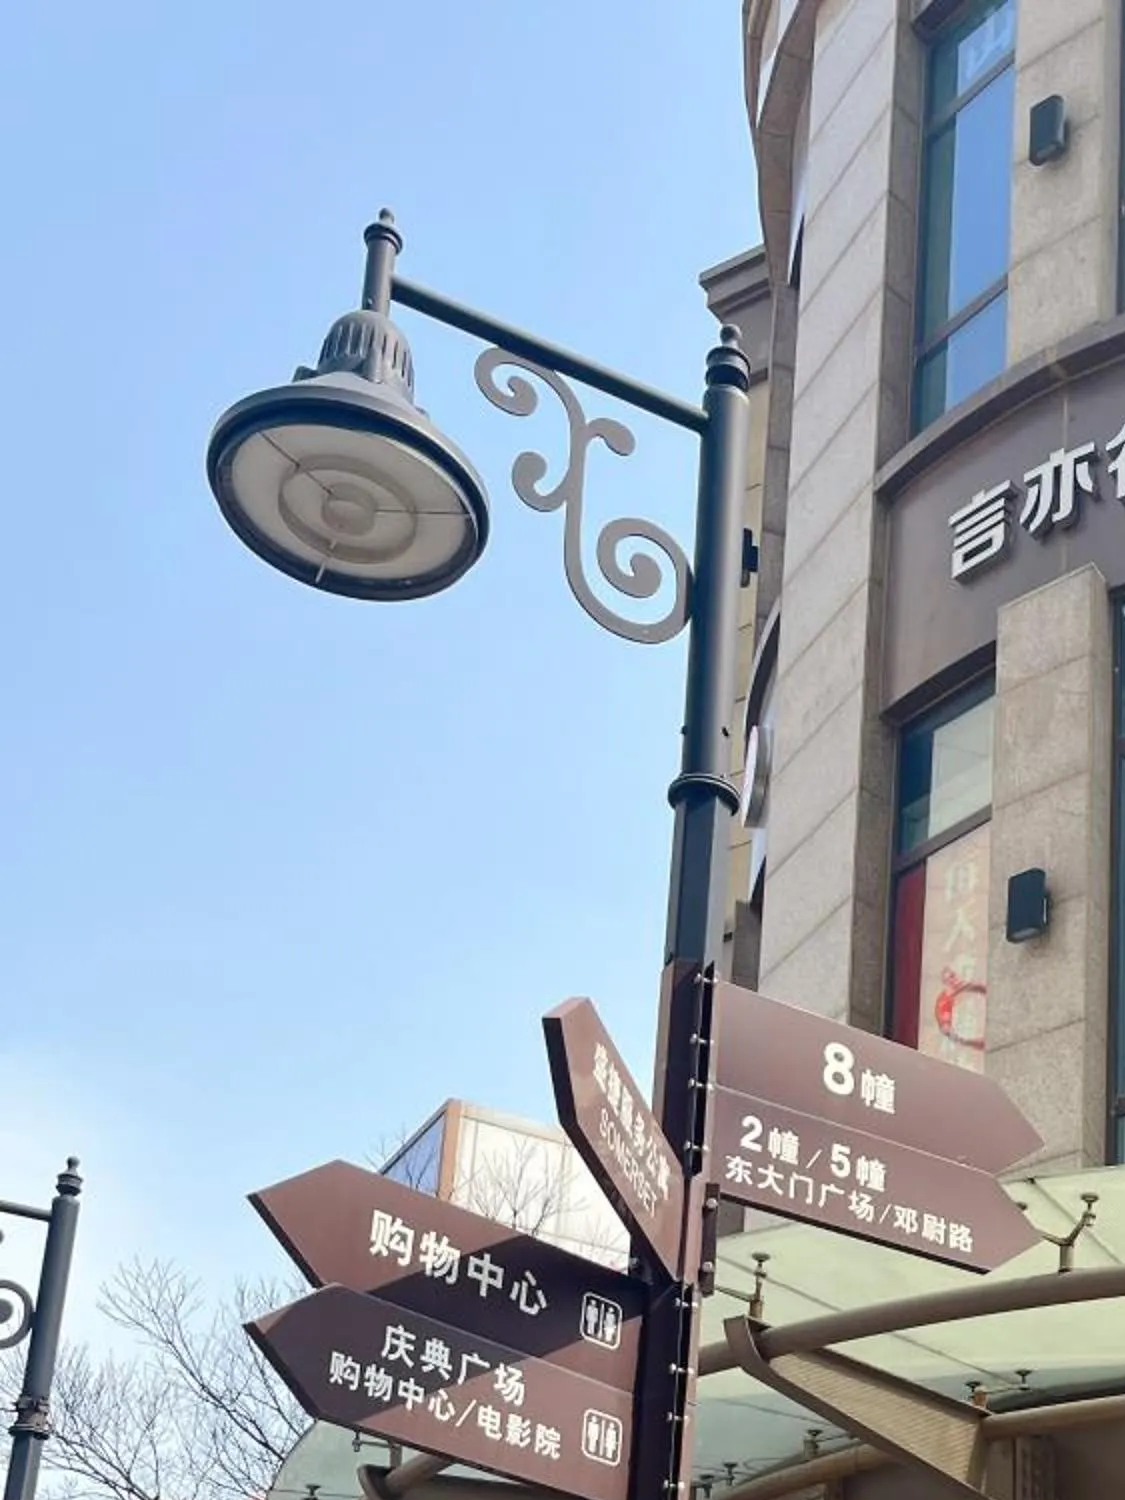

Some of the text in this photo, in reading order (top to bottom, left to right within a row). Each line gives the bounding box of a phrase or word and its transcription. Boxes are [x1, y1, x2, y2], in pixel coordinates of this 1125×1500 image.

[823, 1042, 895, 1114] 8幢
[600, 1108, 657, 1217] SOMERSET
[725, 1155, 973, 1252] 东大门广场/邓尉路
[369, 1209, 547, 1316] 购物中心
[329, 1351, 561, 1460] 购物中心/电影院
[382, 1325, 525, 1406] 庆典广场
